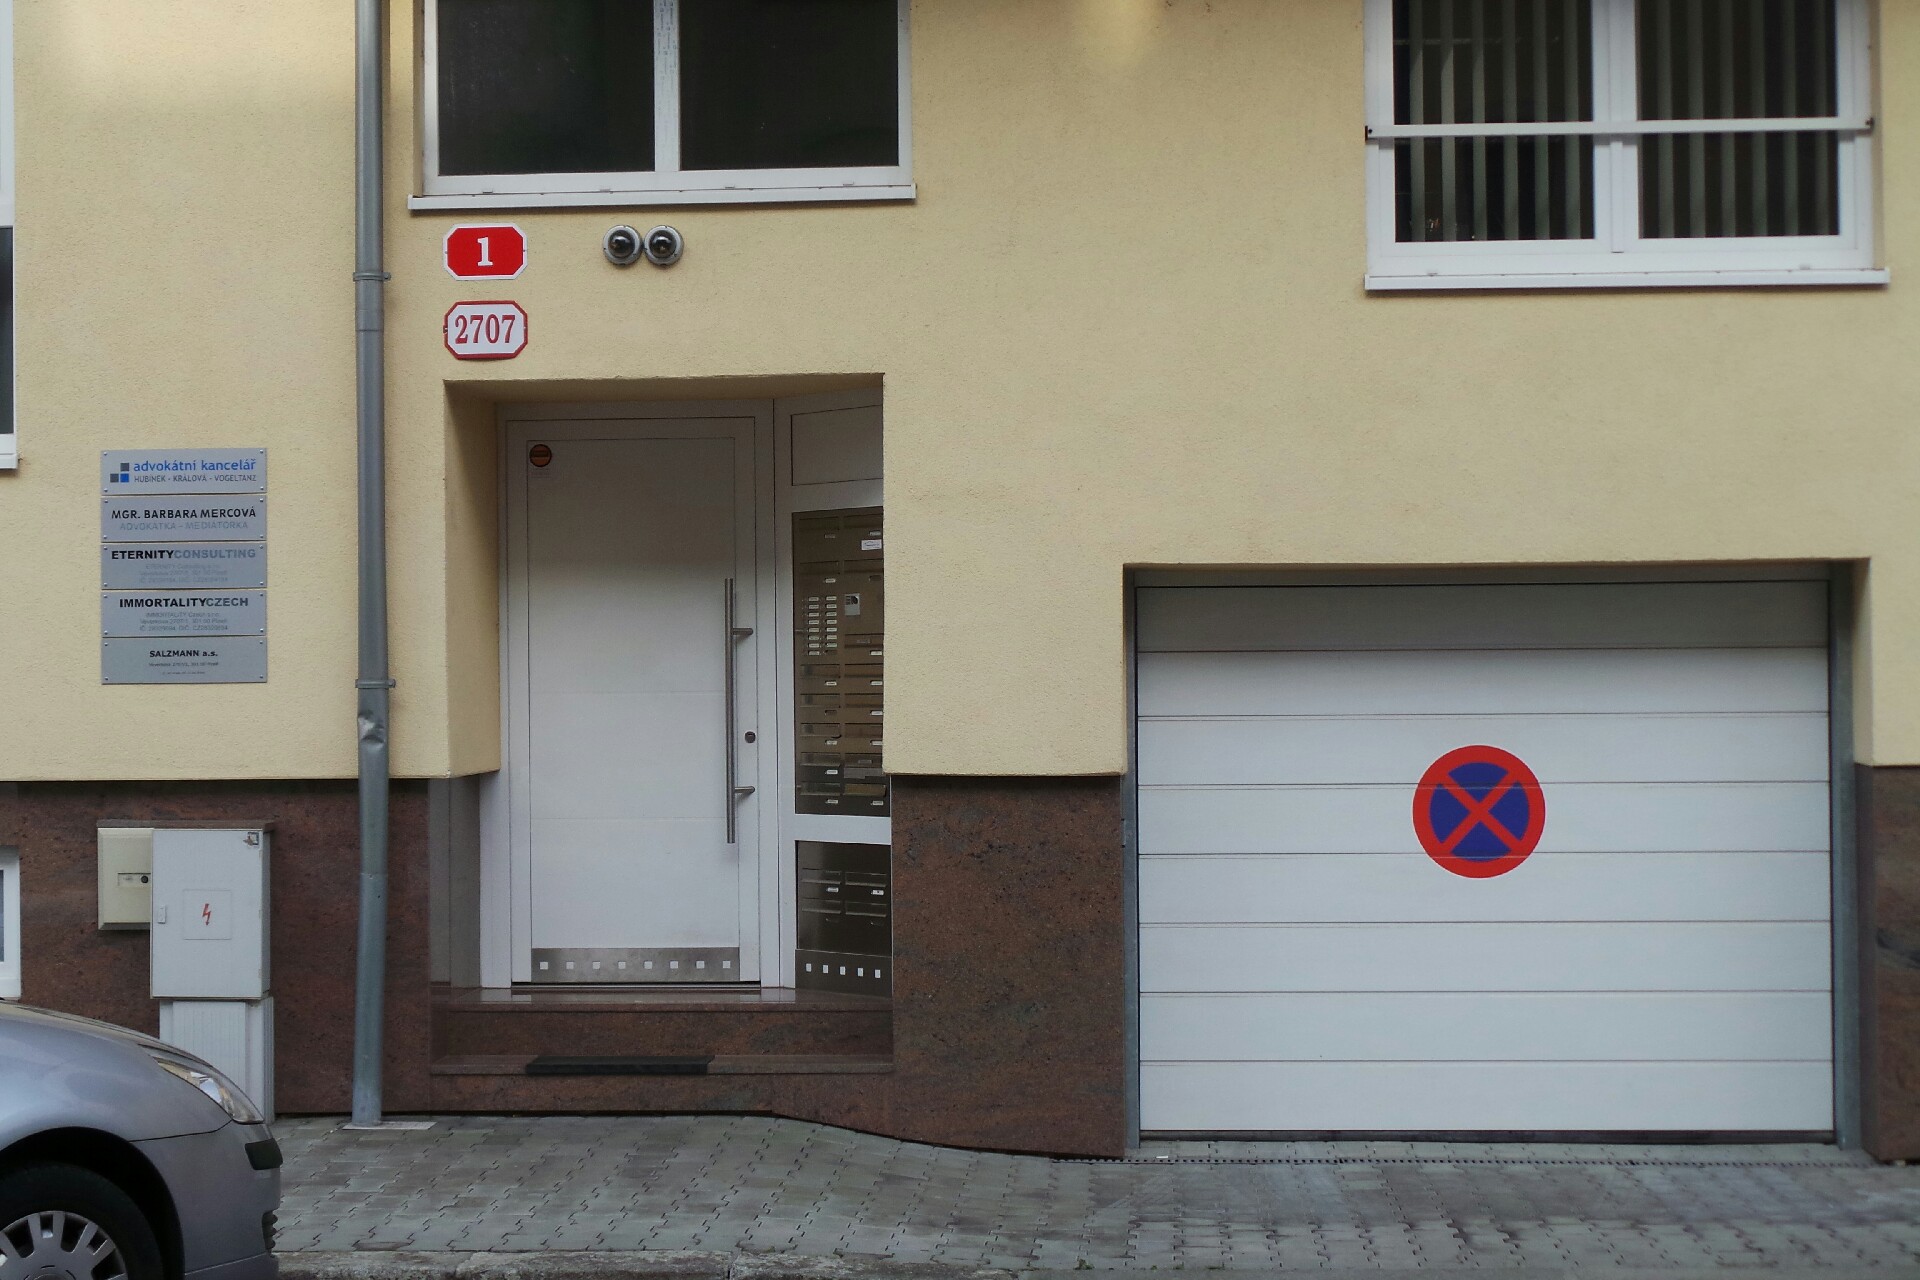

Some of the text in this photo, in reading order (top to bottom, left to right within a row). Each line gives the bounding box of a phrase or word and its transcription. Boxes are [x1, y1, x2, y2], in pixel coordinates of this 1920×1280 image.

[477, 236, 493, 267] 1
[454, 313, 516, 345] 2707
[133, 458, 256, 472] advokátní kancelář
[111, 506, 256, 519] MGR. BARBARA MERCOVÁ
[149, 650, 200, 658] SALZMANN
